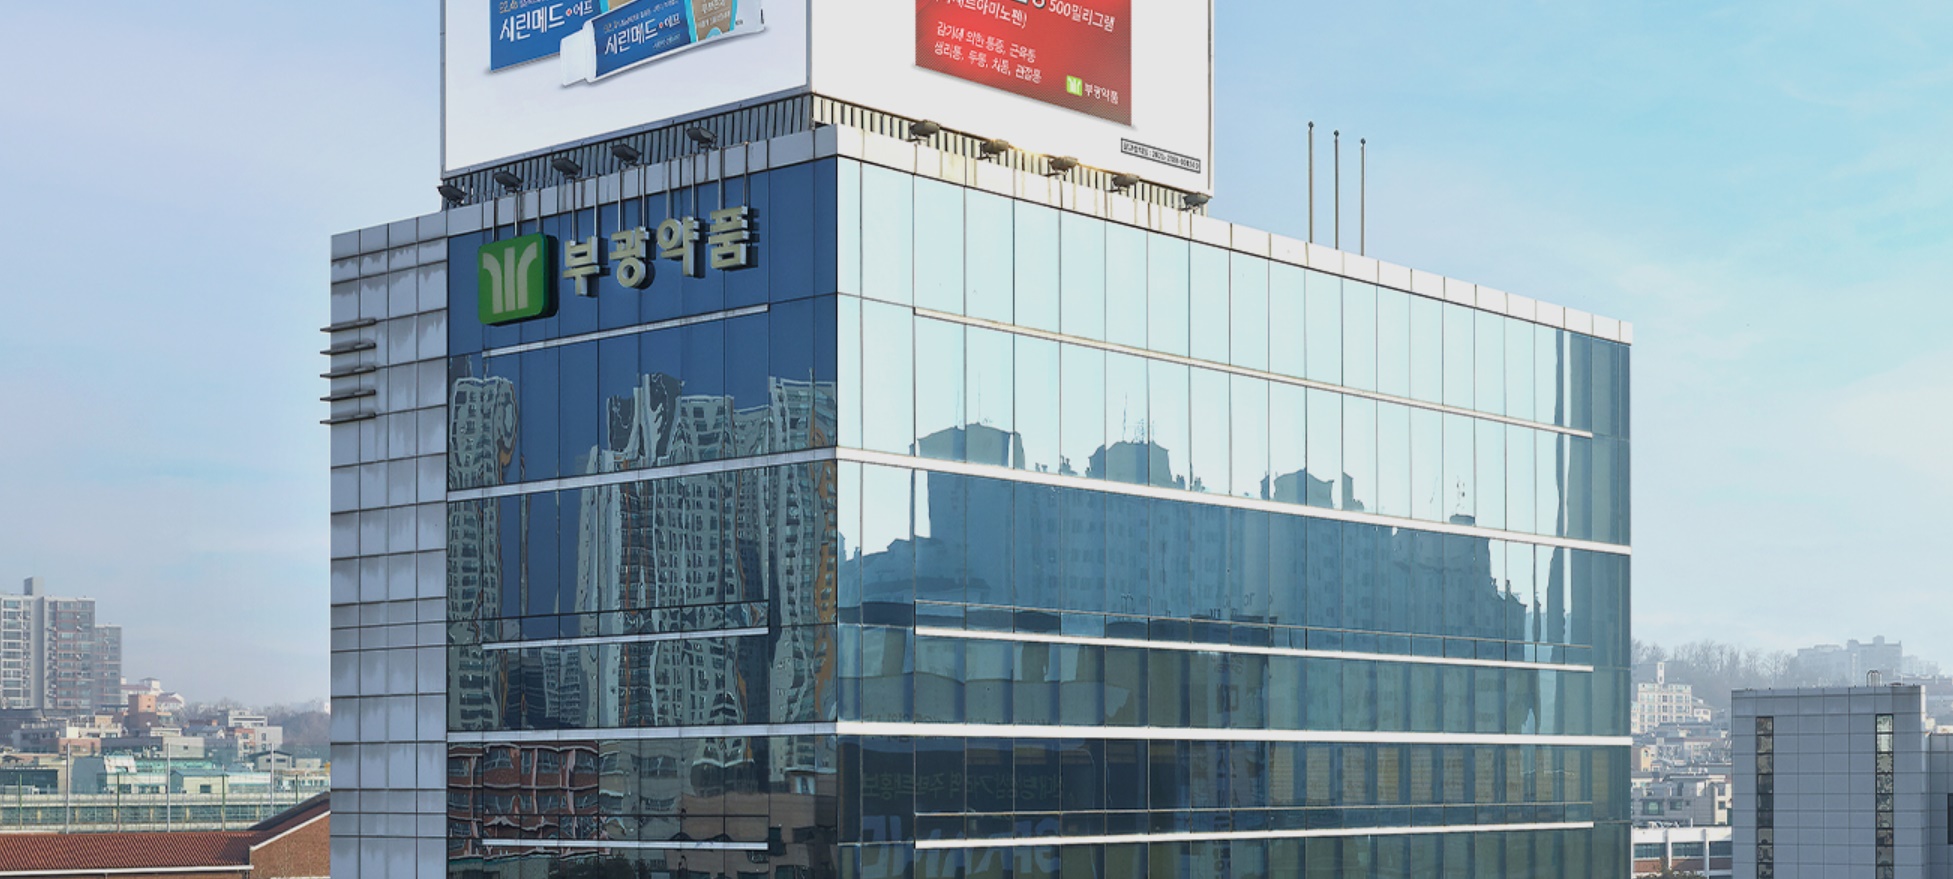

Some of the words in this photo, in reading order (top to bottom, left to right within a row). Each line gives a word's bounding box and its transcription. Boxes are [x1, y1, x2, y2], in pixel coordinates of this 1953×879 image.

[499, 3, 565, 42] 시린메드
[1048, 0, 1115, 32] 500밀리그램
[604, 18, 658, 55] 시린메드
[937, 21, 964, 41] 감기에
[966, 30, 985, 49] 의한
[1009, 42, 1036, 63] 근육통
[934, 41, 964, 61] 생리통,
[968, 49, 989, 69] 두통,
[991, 57, 1011, 76] 치통,
[1015, 63, 1042, 84] 관절통
[1084, 82, 1119, 105] 부광약품
[562, 205, 749, 297] 부광약품
